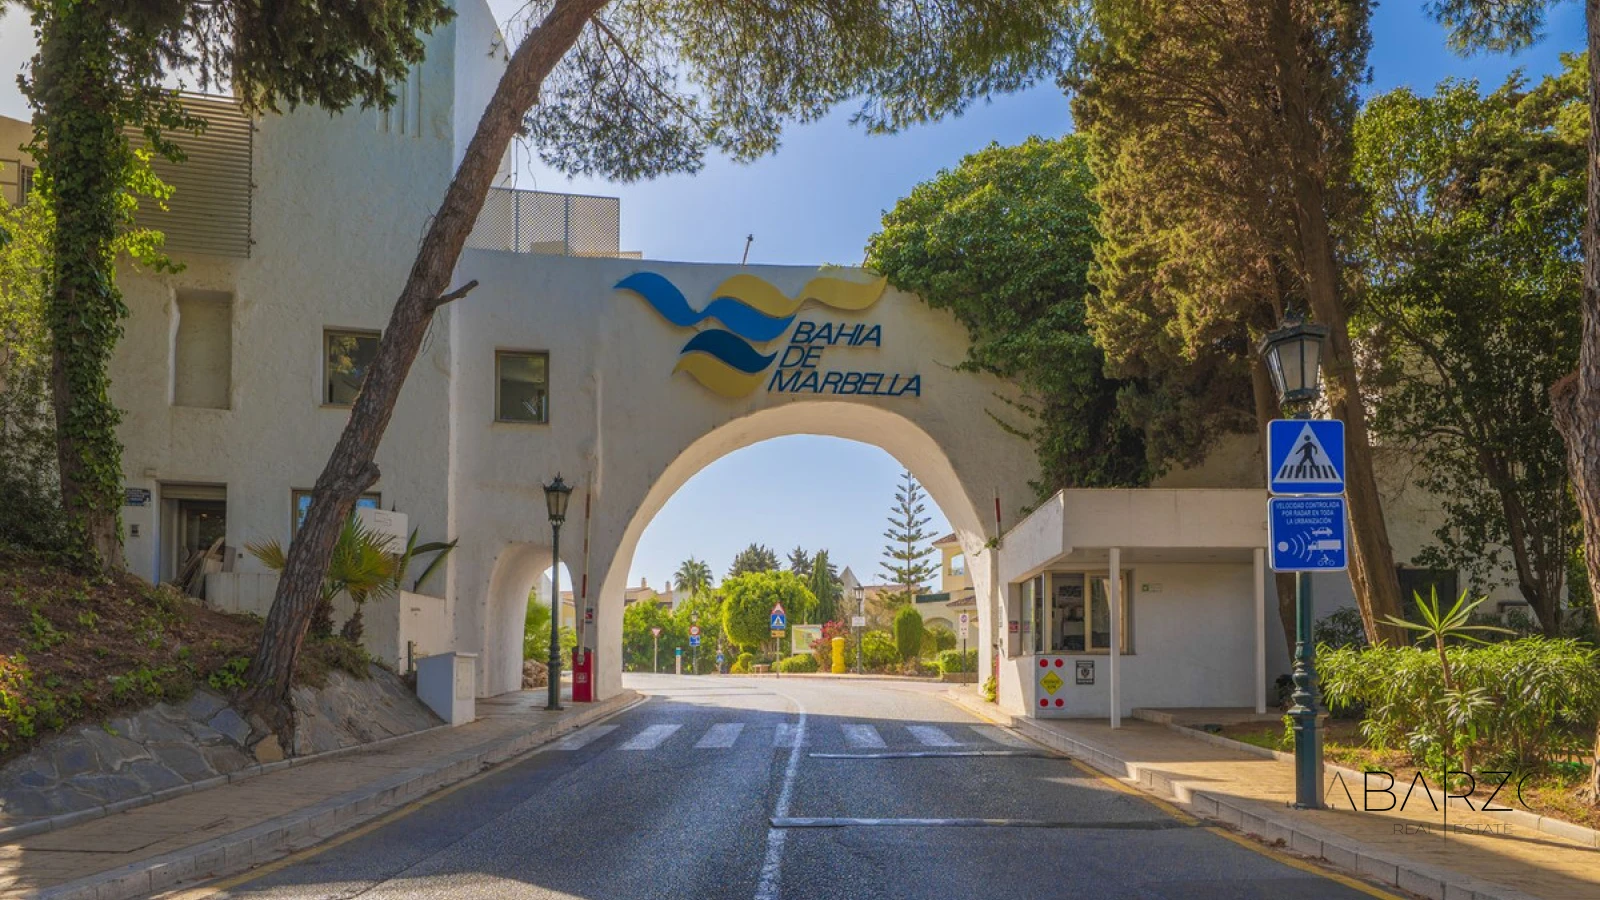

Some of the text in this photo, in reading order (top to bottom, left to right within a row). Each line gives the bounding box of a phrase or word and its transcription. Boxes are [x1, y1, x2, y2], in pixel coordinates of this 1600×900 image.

[791, 321, 882, 347] BAHIA
[779, 345, 825, 368] DE
[767, 369, 921, 397] MARBELLA
[1305, 501, 1340, 509] CONTROLADA
